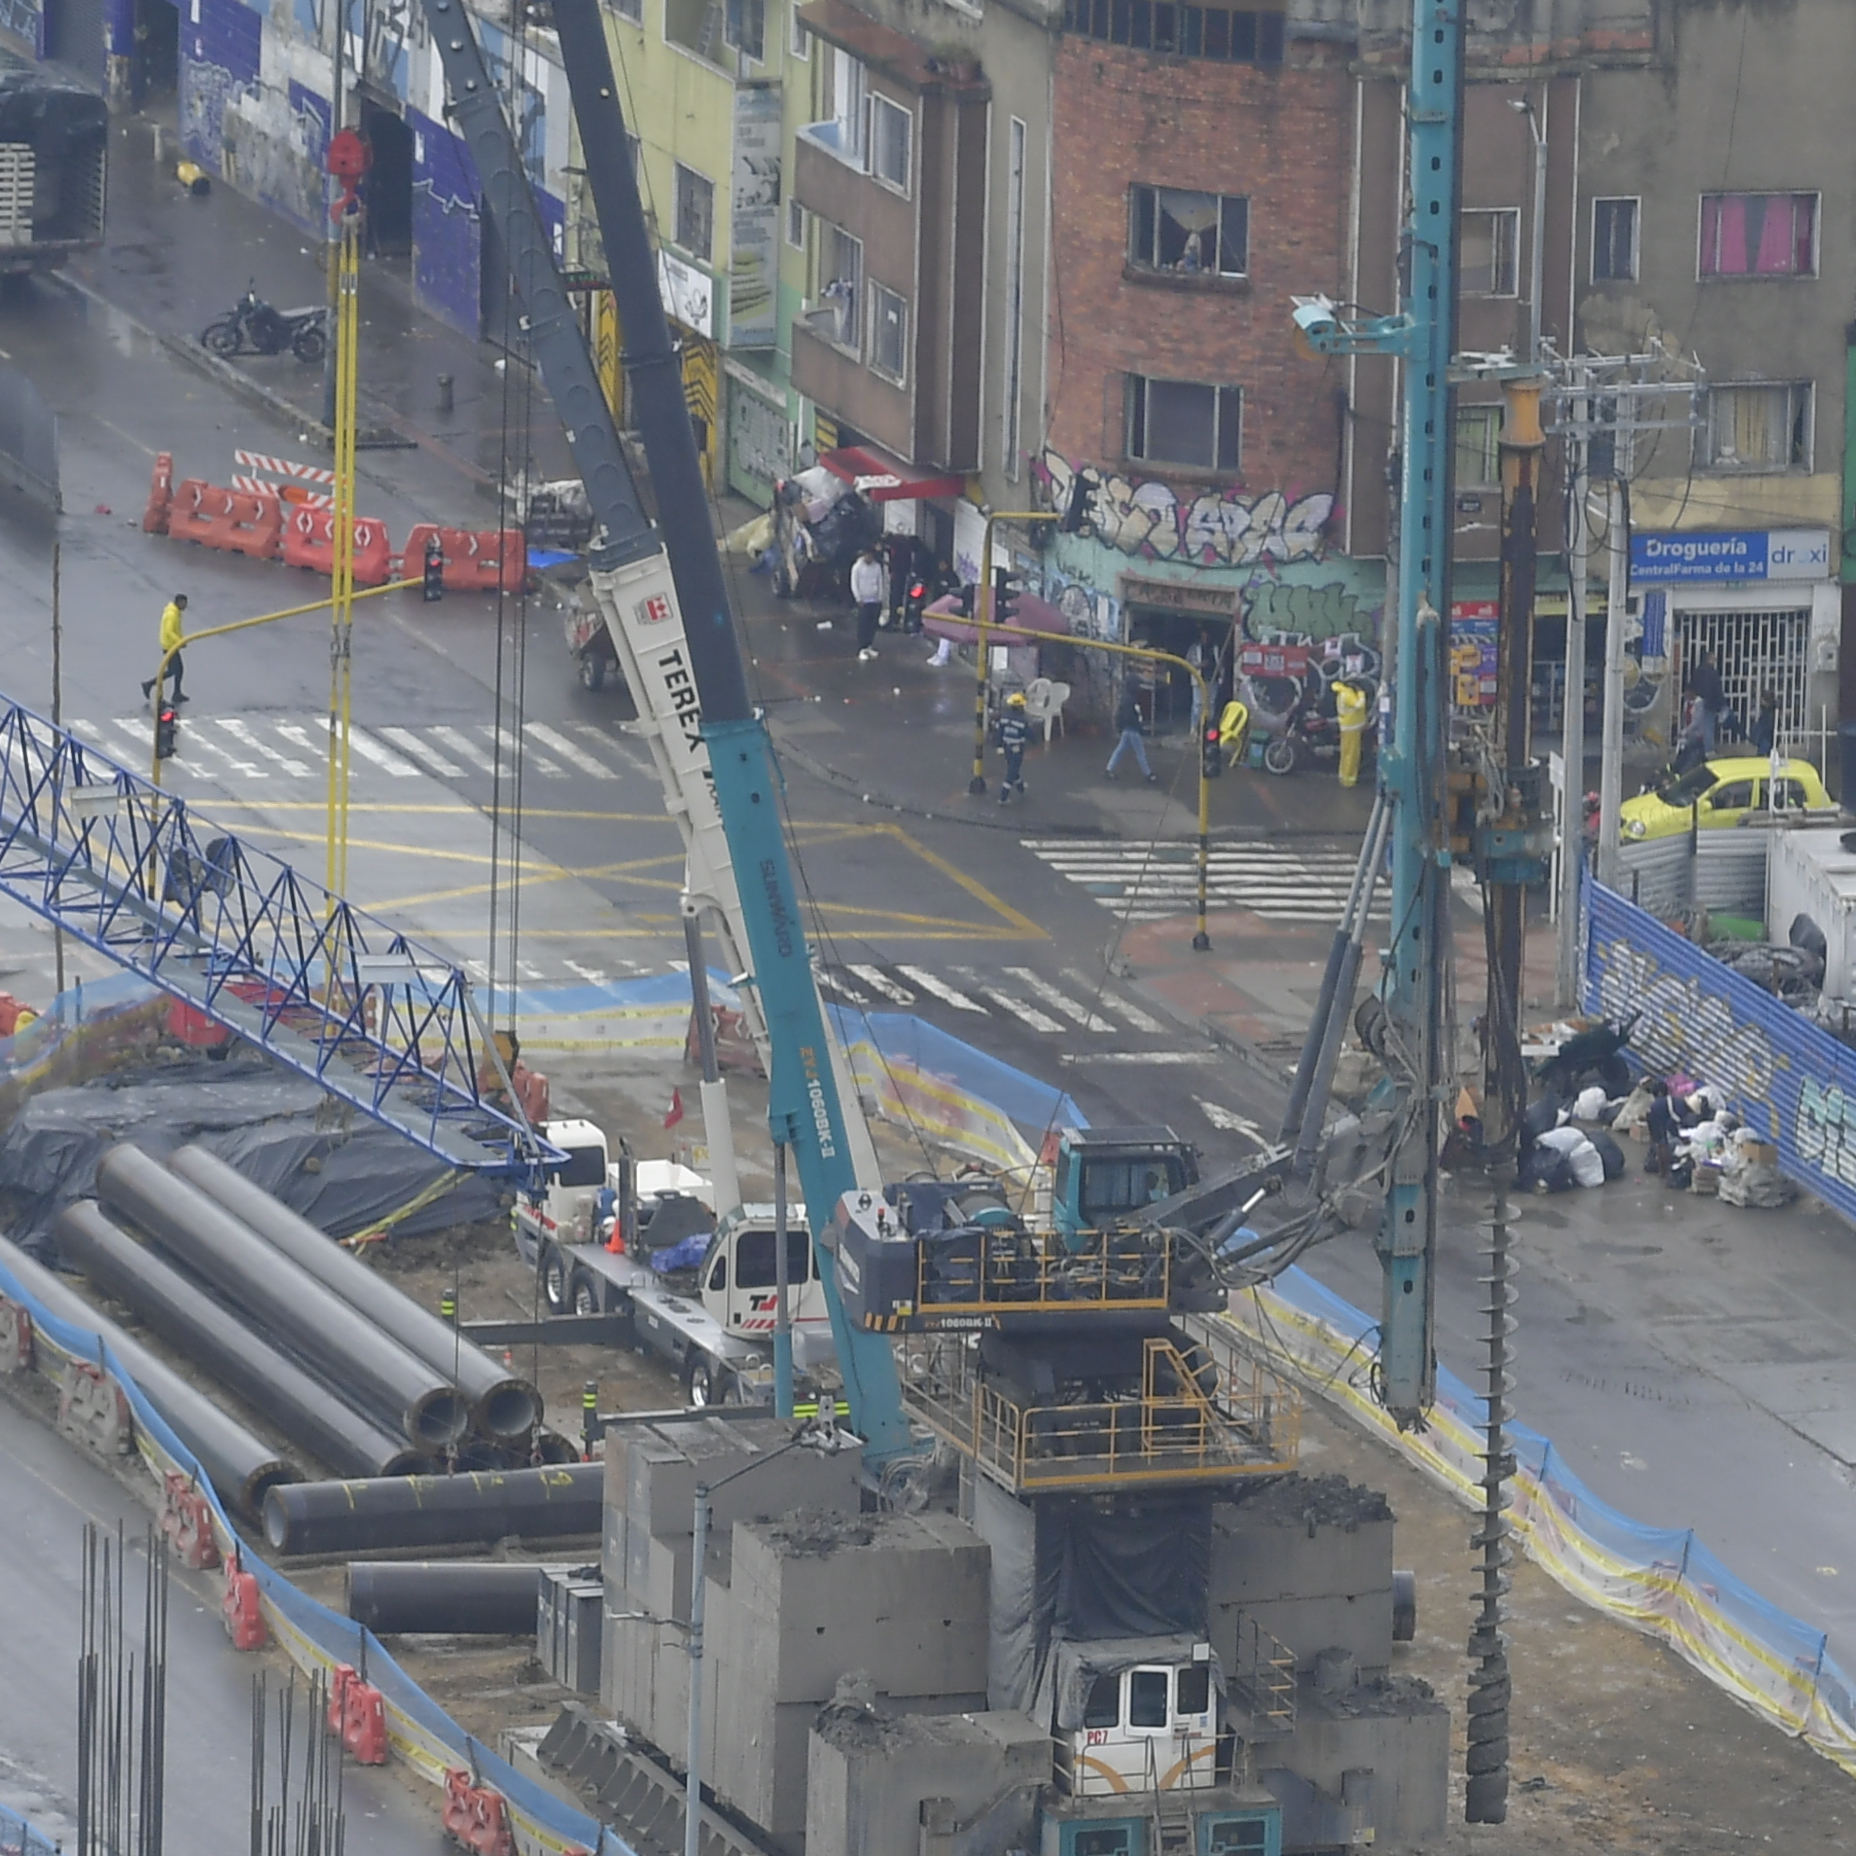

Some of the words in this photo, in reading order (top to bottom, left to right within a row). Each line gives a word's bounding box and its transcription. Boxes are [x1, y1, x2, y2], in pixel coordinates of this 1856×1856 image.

[1647, 538, 1747, 560] Droguería
[1630, 562, 1712, 576] CentralFarma
[1715, 561, 1730, 574] de
[1734, 561, 1745, 574] la
[1748, 561, 1764, 574] 24
[657, 648, 705, 754] TEREX
[1087, 1730, 1109, 1746] PC7
